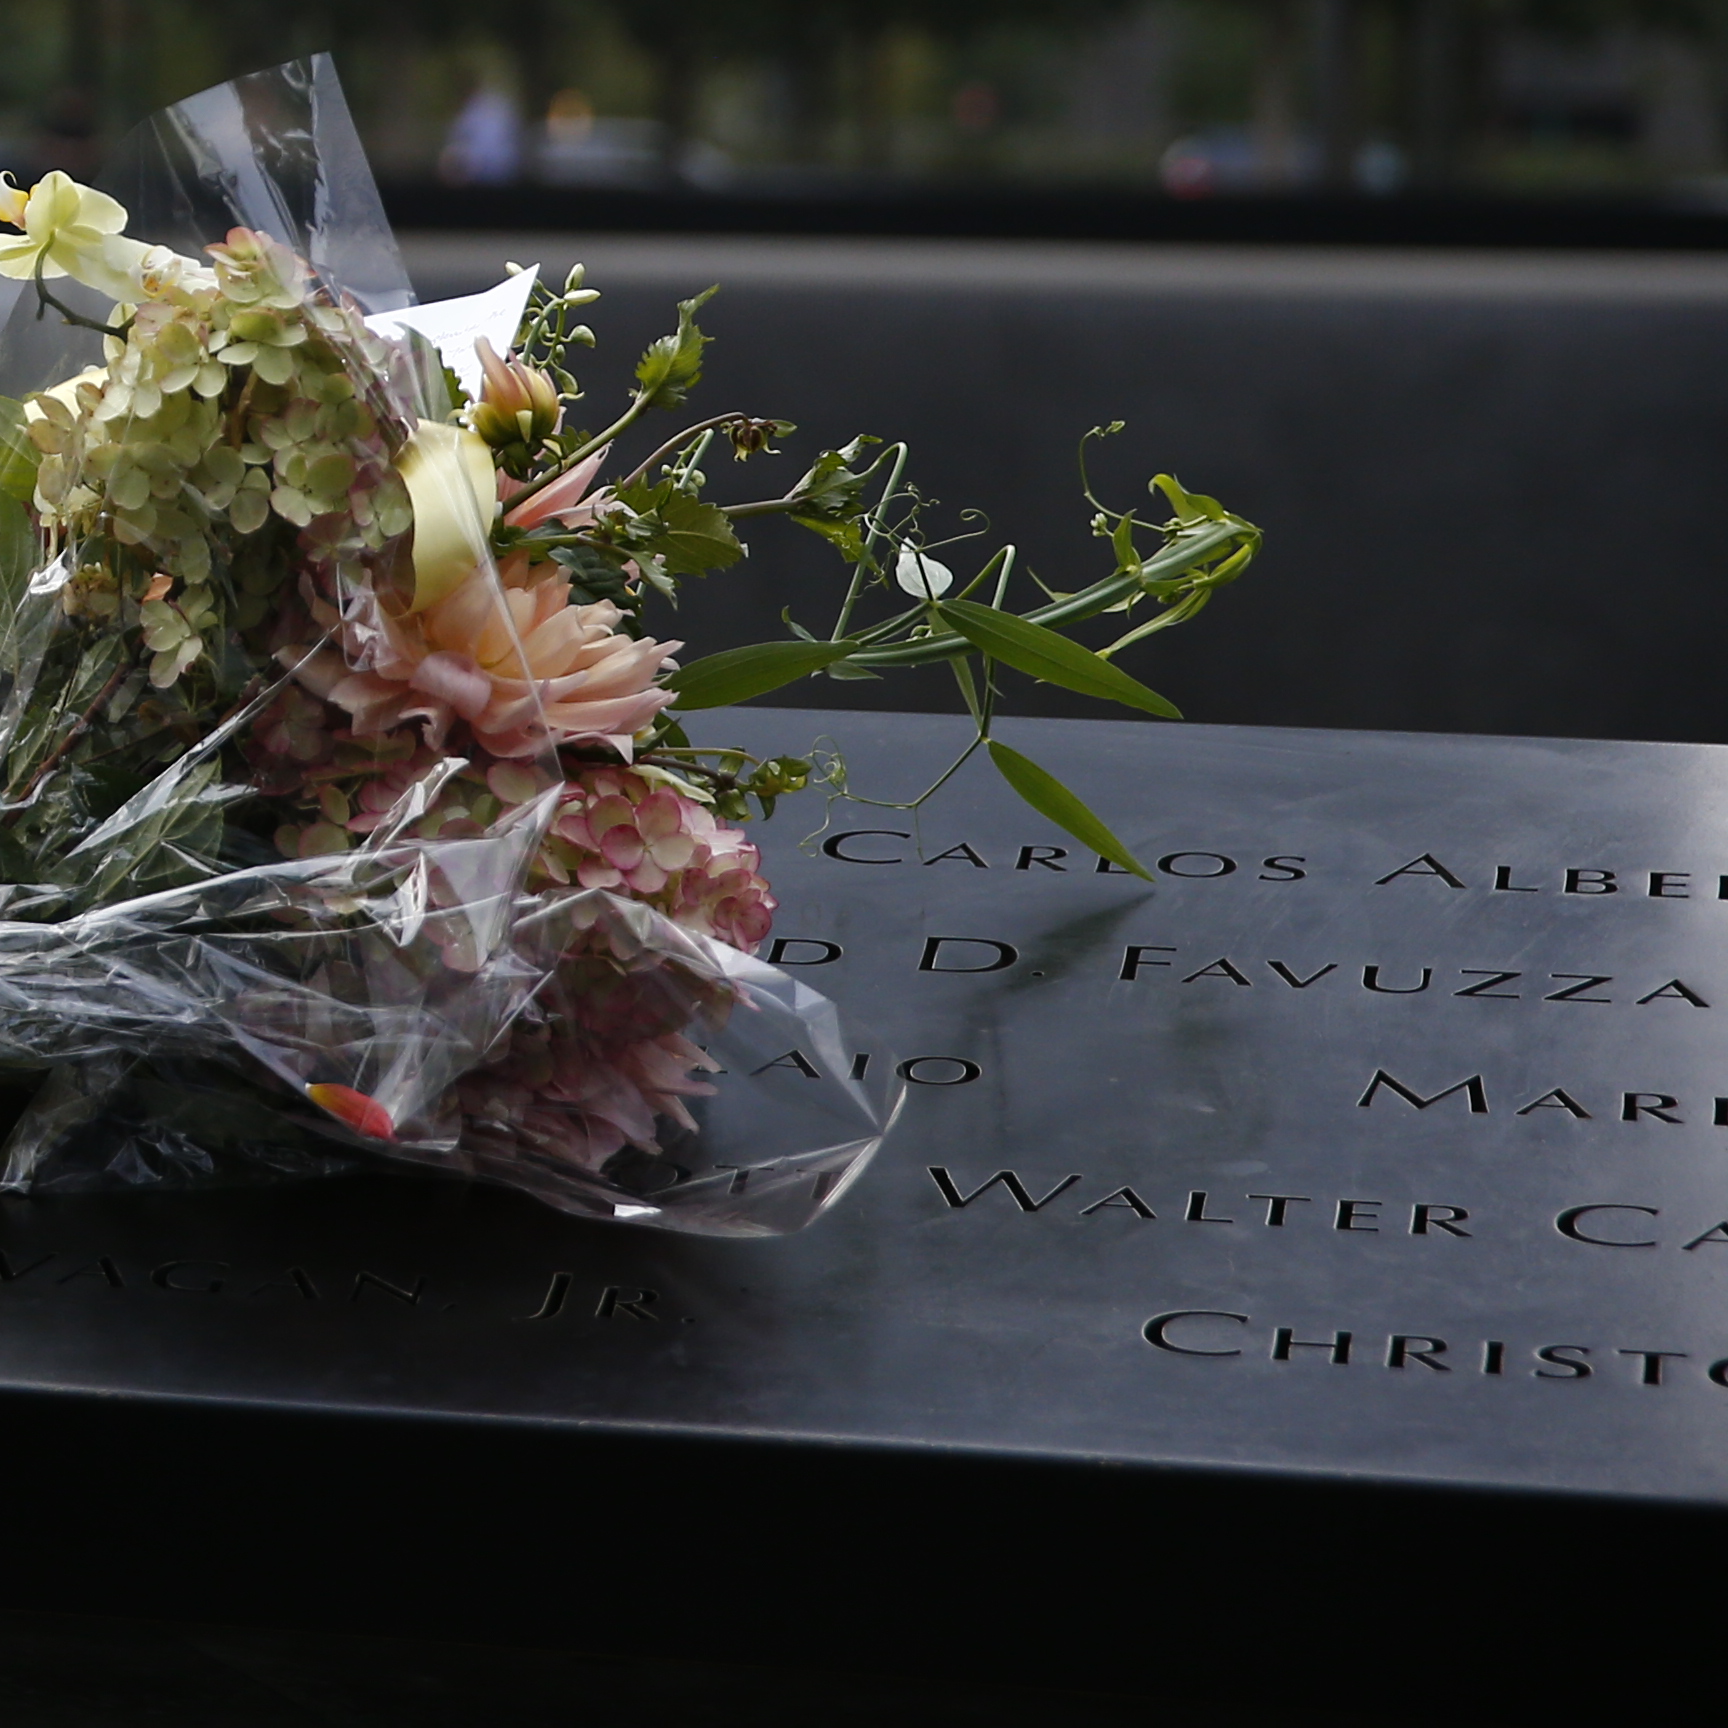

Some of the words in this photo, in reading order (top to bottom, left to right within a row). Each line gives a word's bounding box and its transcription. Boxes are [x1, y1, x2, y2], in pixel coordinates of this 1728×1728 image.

[822, 830, 1308, 882] CARLOS
[765, 937, 844, 966] D
[917, 936, 1044, 977] D.
[1117, 945, 1712, 1009] FAVUZZA
[926, 1165, 1473, 1238] WALTER
[512, 1272, 696, 1325] JR.
[1142, 1309, 1728, 1394] CHRIST
